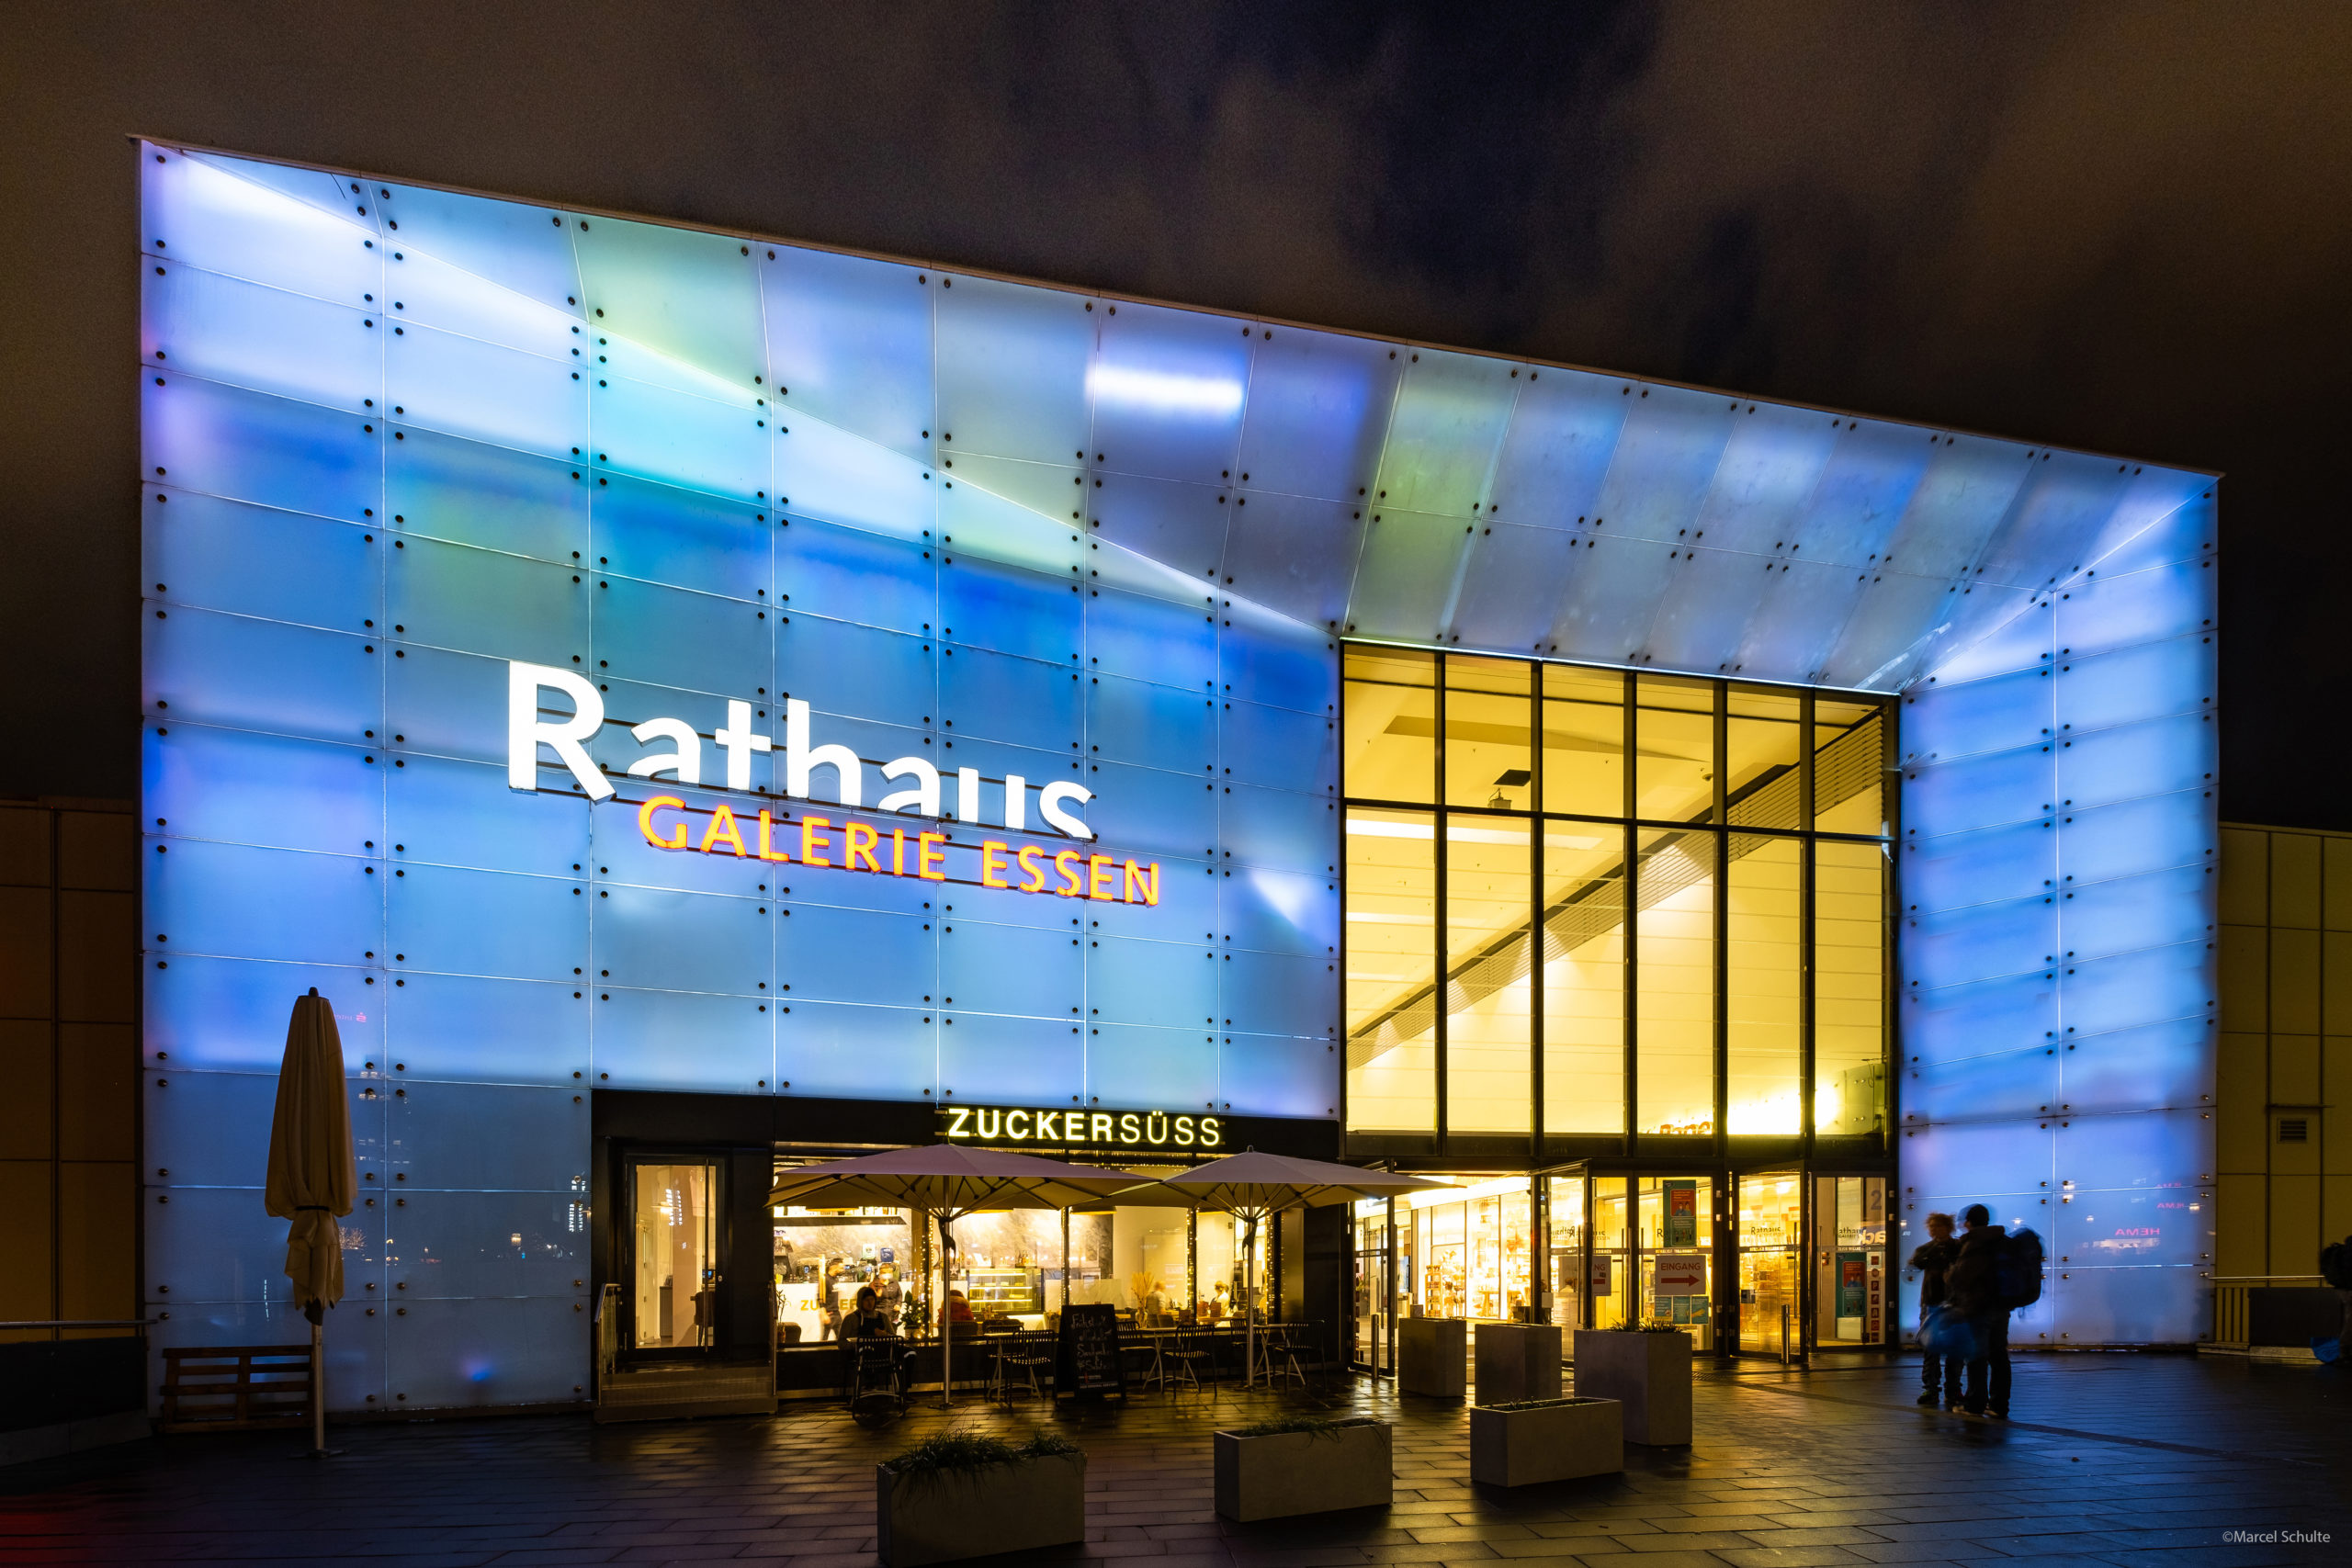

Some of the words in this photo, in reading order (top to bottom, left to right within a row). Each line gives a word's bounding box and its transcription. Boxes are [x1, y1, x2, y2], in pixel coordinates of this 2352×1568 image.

[509, 660, 1093, 840] Rathaus
[639, 795, 945, 881] GALERIE
[983, 840, 1159, 907] ESSEN
[948, 1108, 1220, 1146] ZUCKERSÜSS
[1871, 1190, 1882, 1210] 2
[1660, 1262, 1701, 1271] EINGANG
